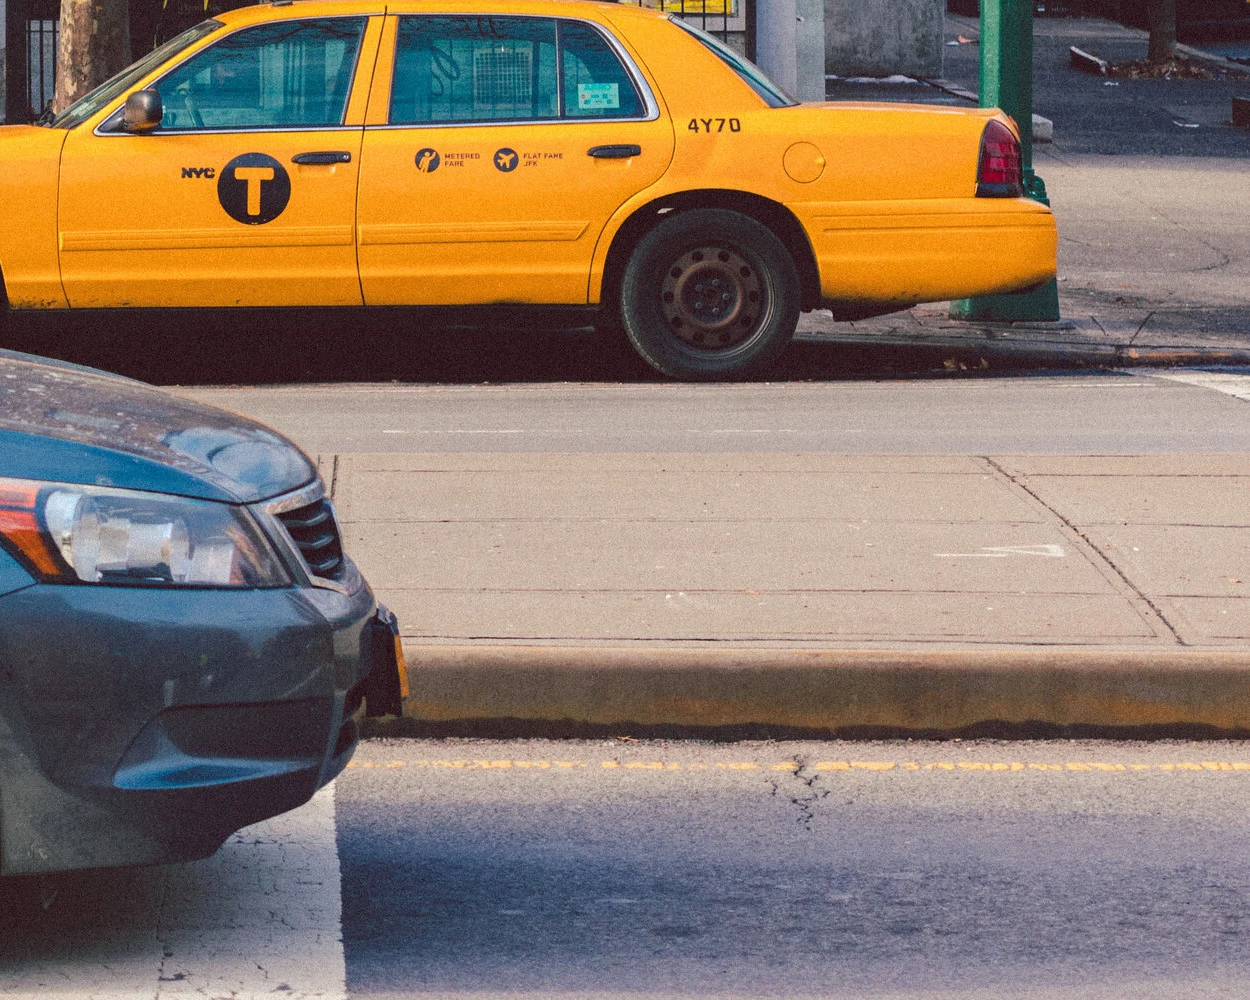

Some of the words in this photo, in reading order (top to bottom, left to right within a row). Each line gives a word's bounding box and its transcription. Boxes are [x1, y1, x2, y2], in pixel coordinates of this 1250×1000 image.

[687, 118, 742, 134] 4Y70
[181, 167, 215, 179] NYC
[234, 167, 275, 216] T
